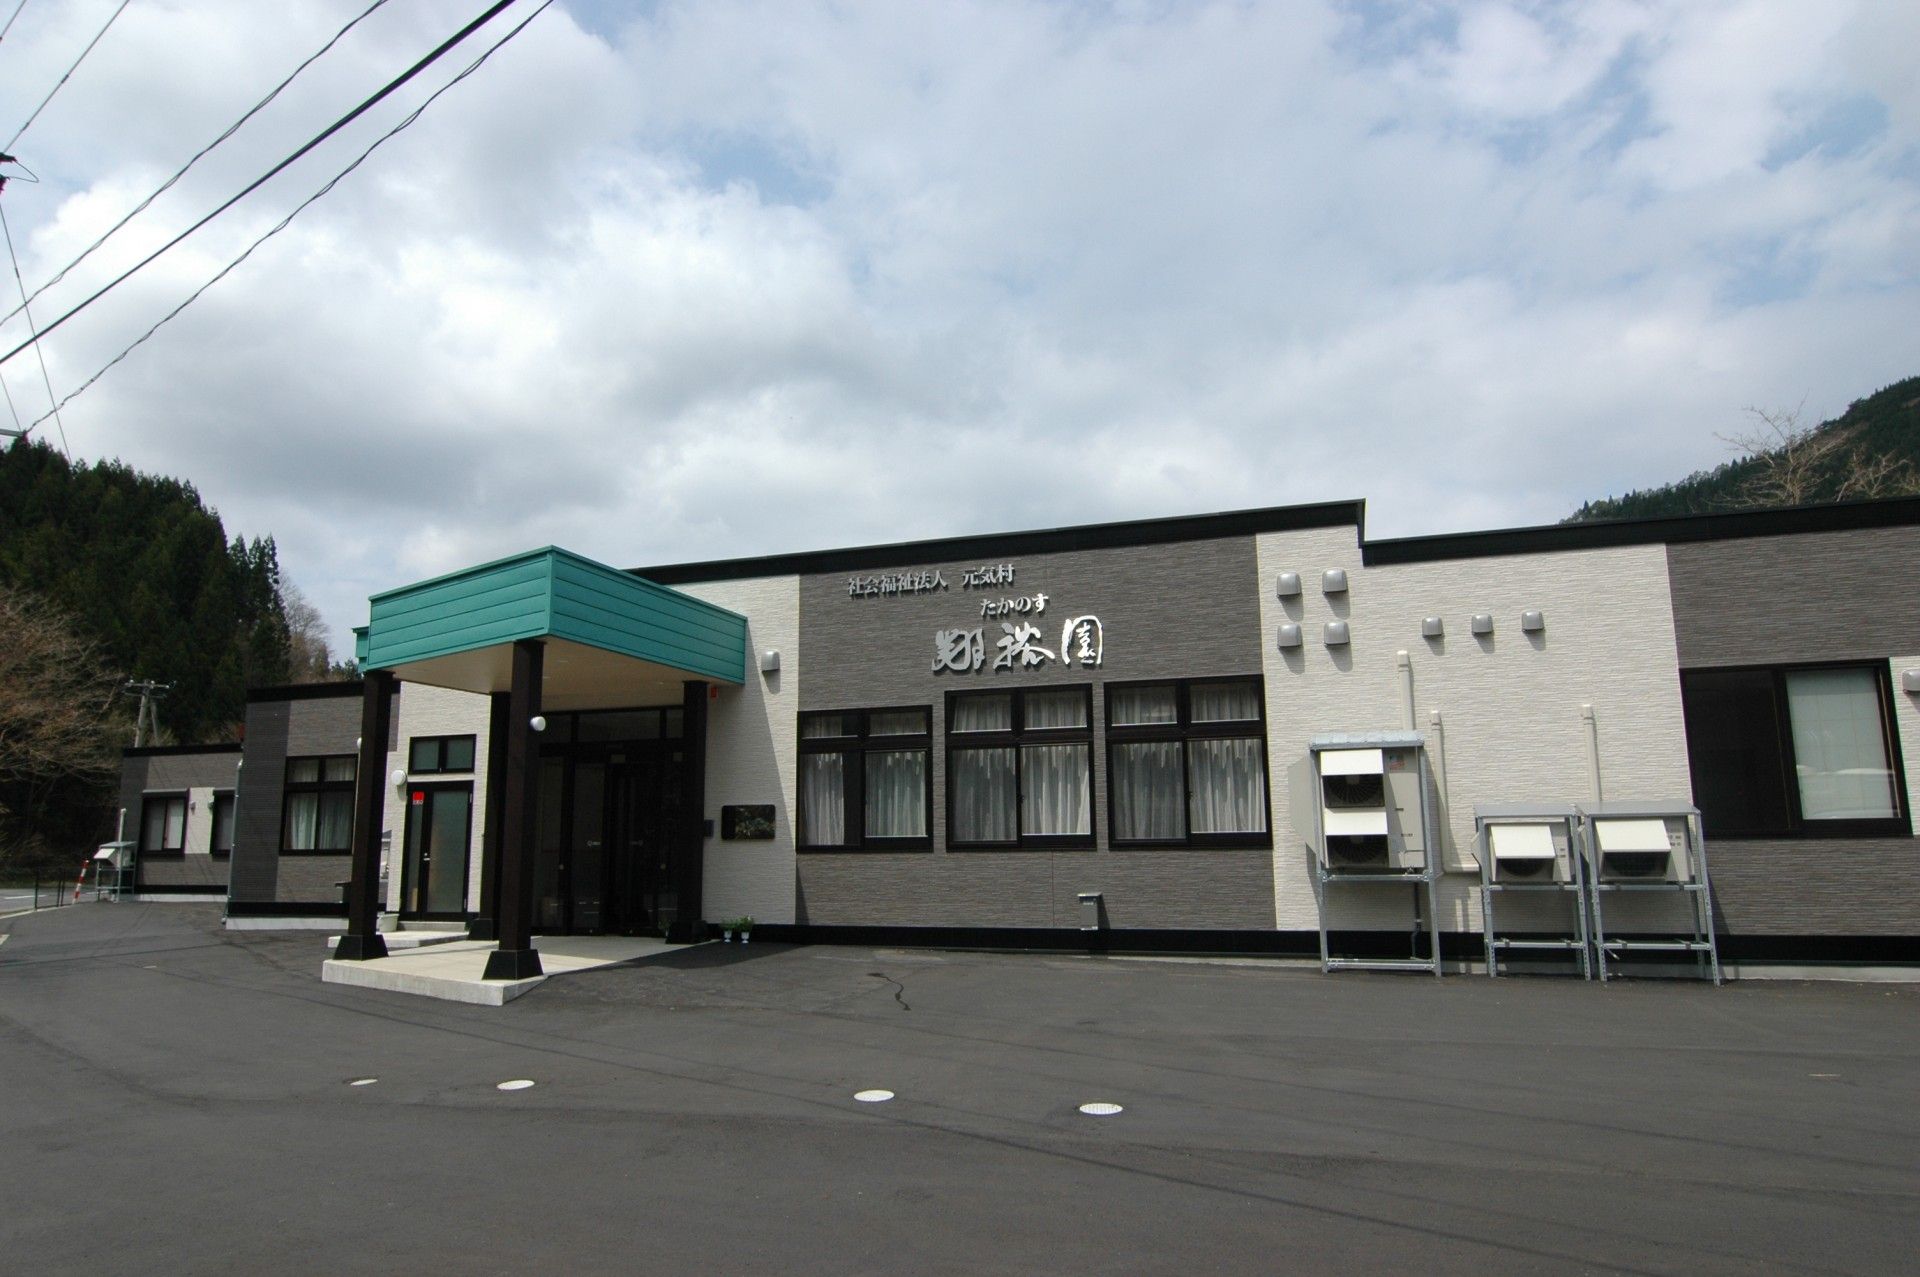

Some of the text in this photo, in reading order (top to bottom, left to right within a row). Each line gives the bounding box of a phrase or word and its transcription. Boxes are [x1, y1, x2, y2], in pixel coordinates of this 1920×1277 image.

[848, 564, 1015, 595] 社会福祉法人 元気村
[980, 593, 1049, 616] たかのす
[932, 615, 1103, 672] 翔裕園
